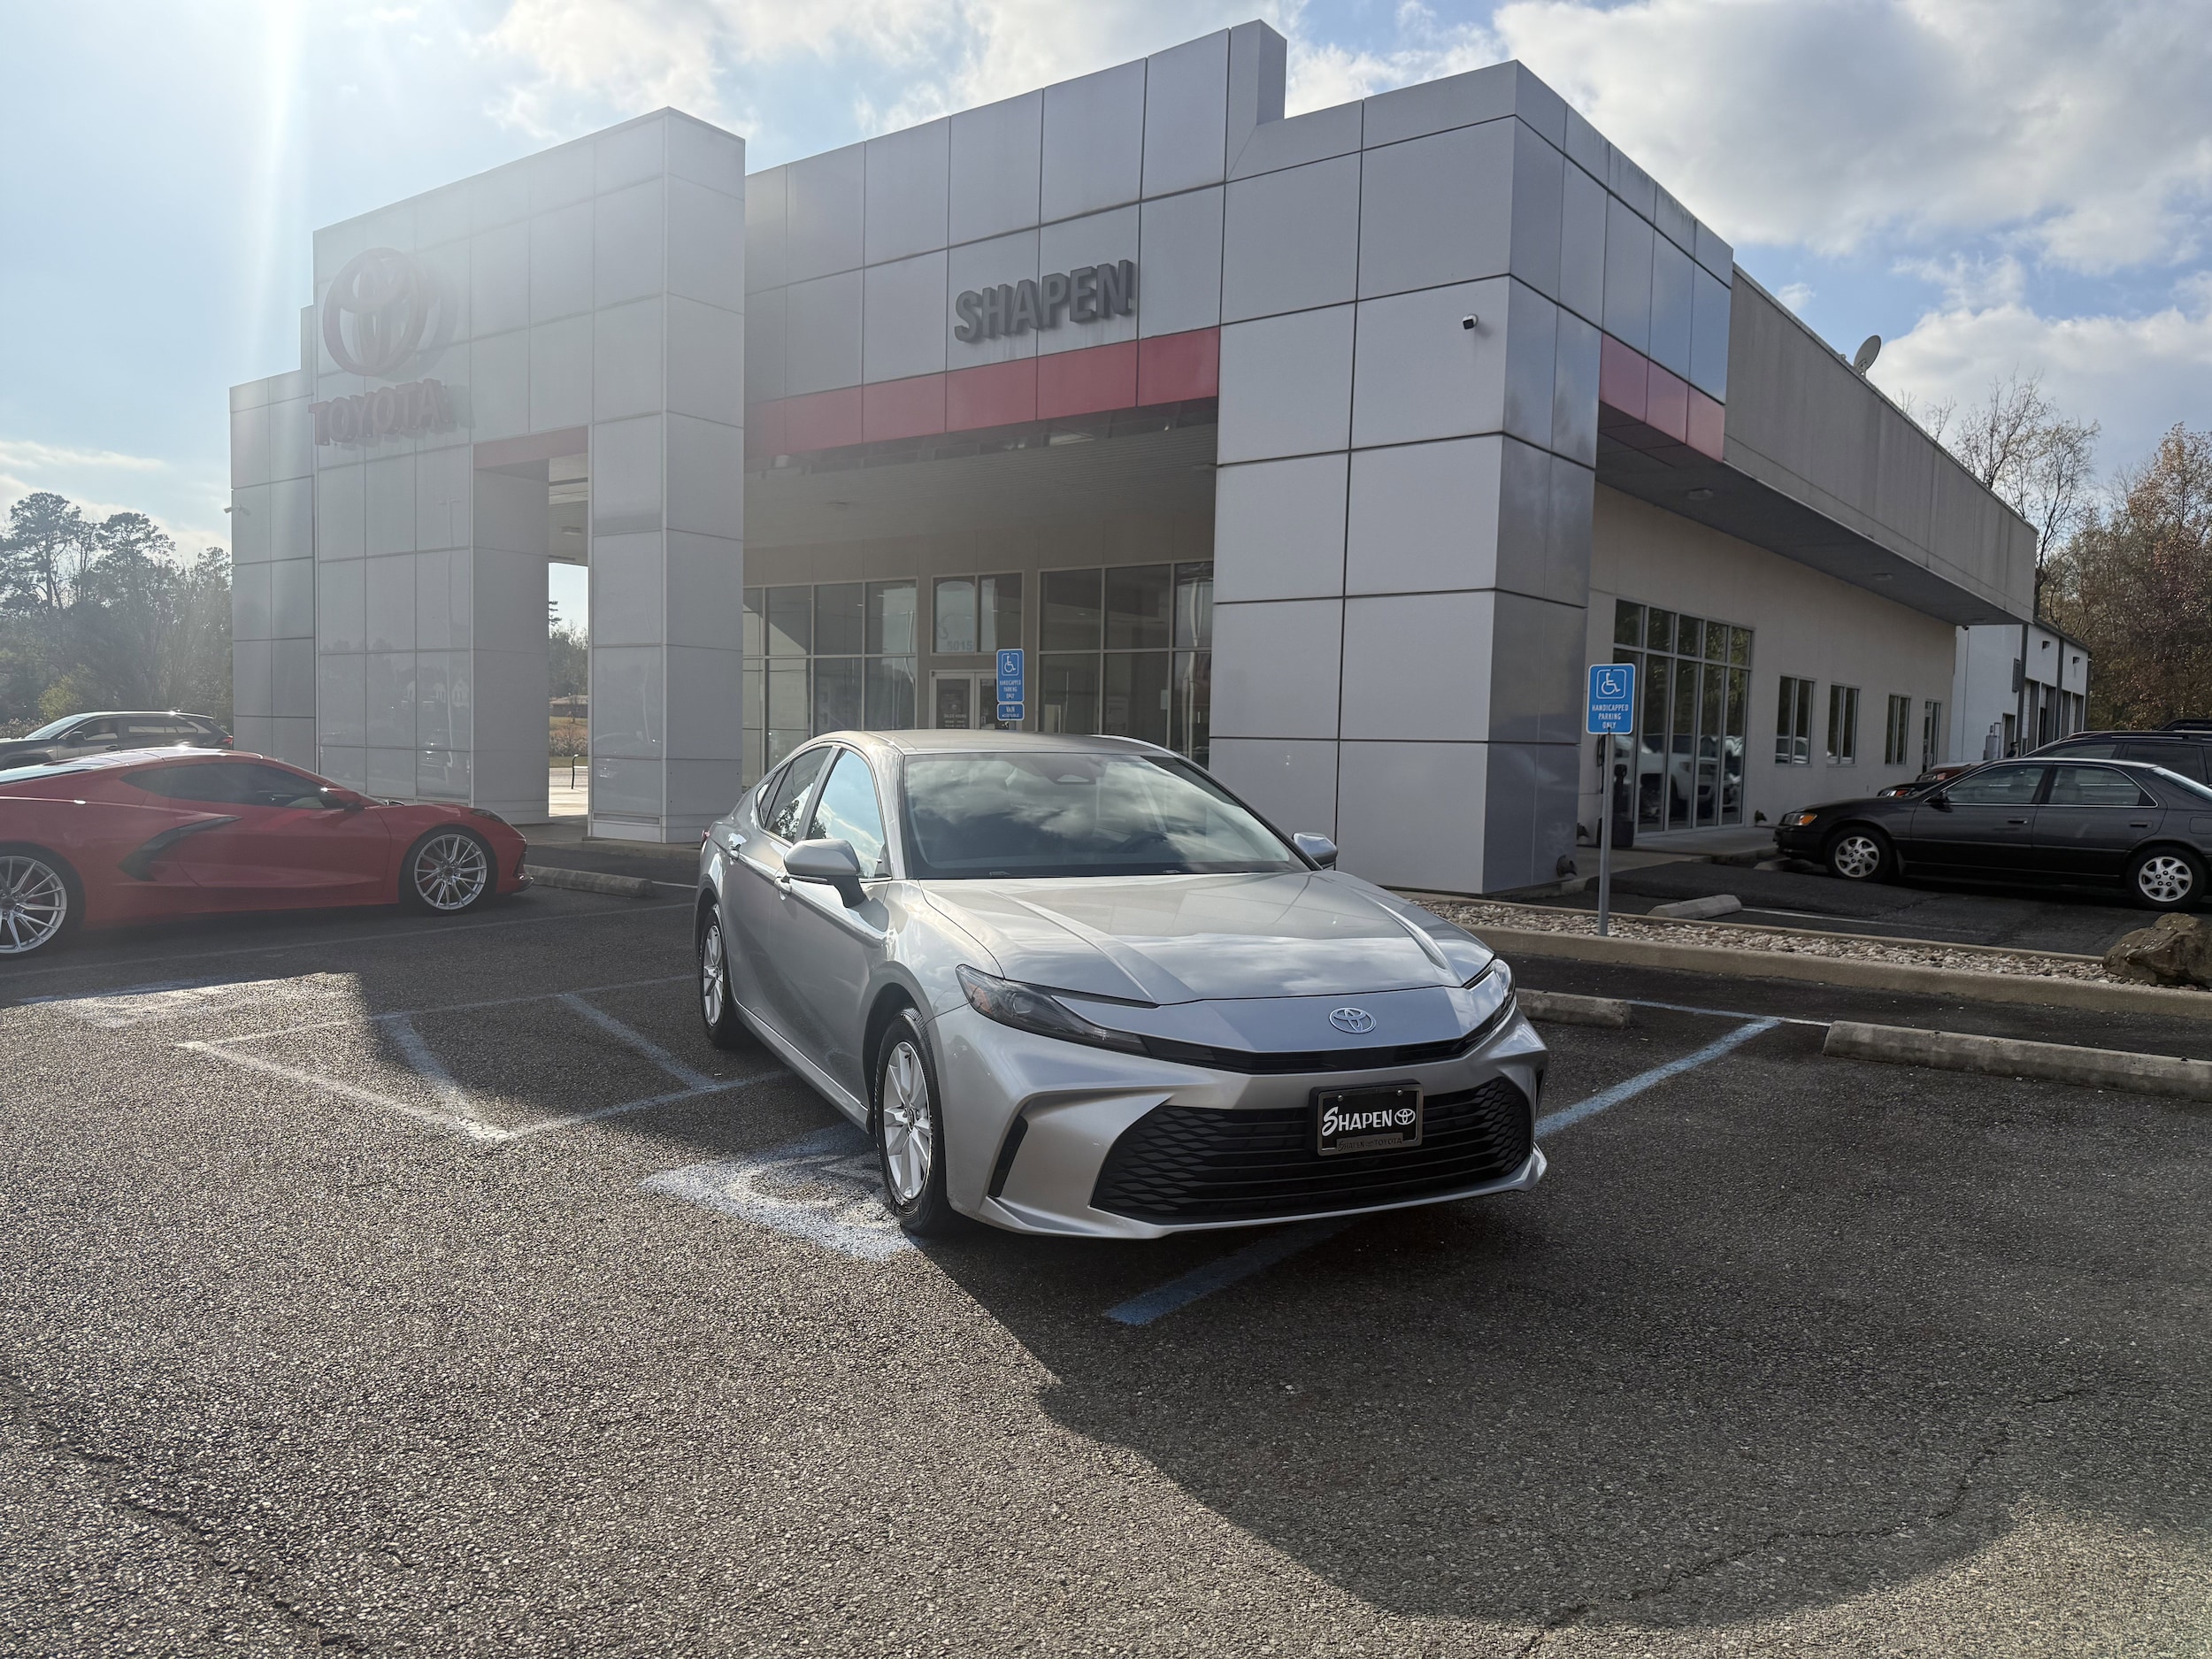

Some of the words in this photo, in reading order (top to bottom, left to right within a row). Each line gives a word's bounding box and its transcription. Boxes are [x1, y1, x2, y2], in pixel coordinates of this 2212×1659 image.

[955, 259, 1133, 343] SHAPEN
[308, 378, 451, 446] TOYOTA
[1321, 1106, 1393, 1137] SHAPEN
[1374, 1137, 1402, 1146] TOYOTA
